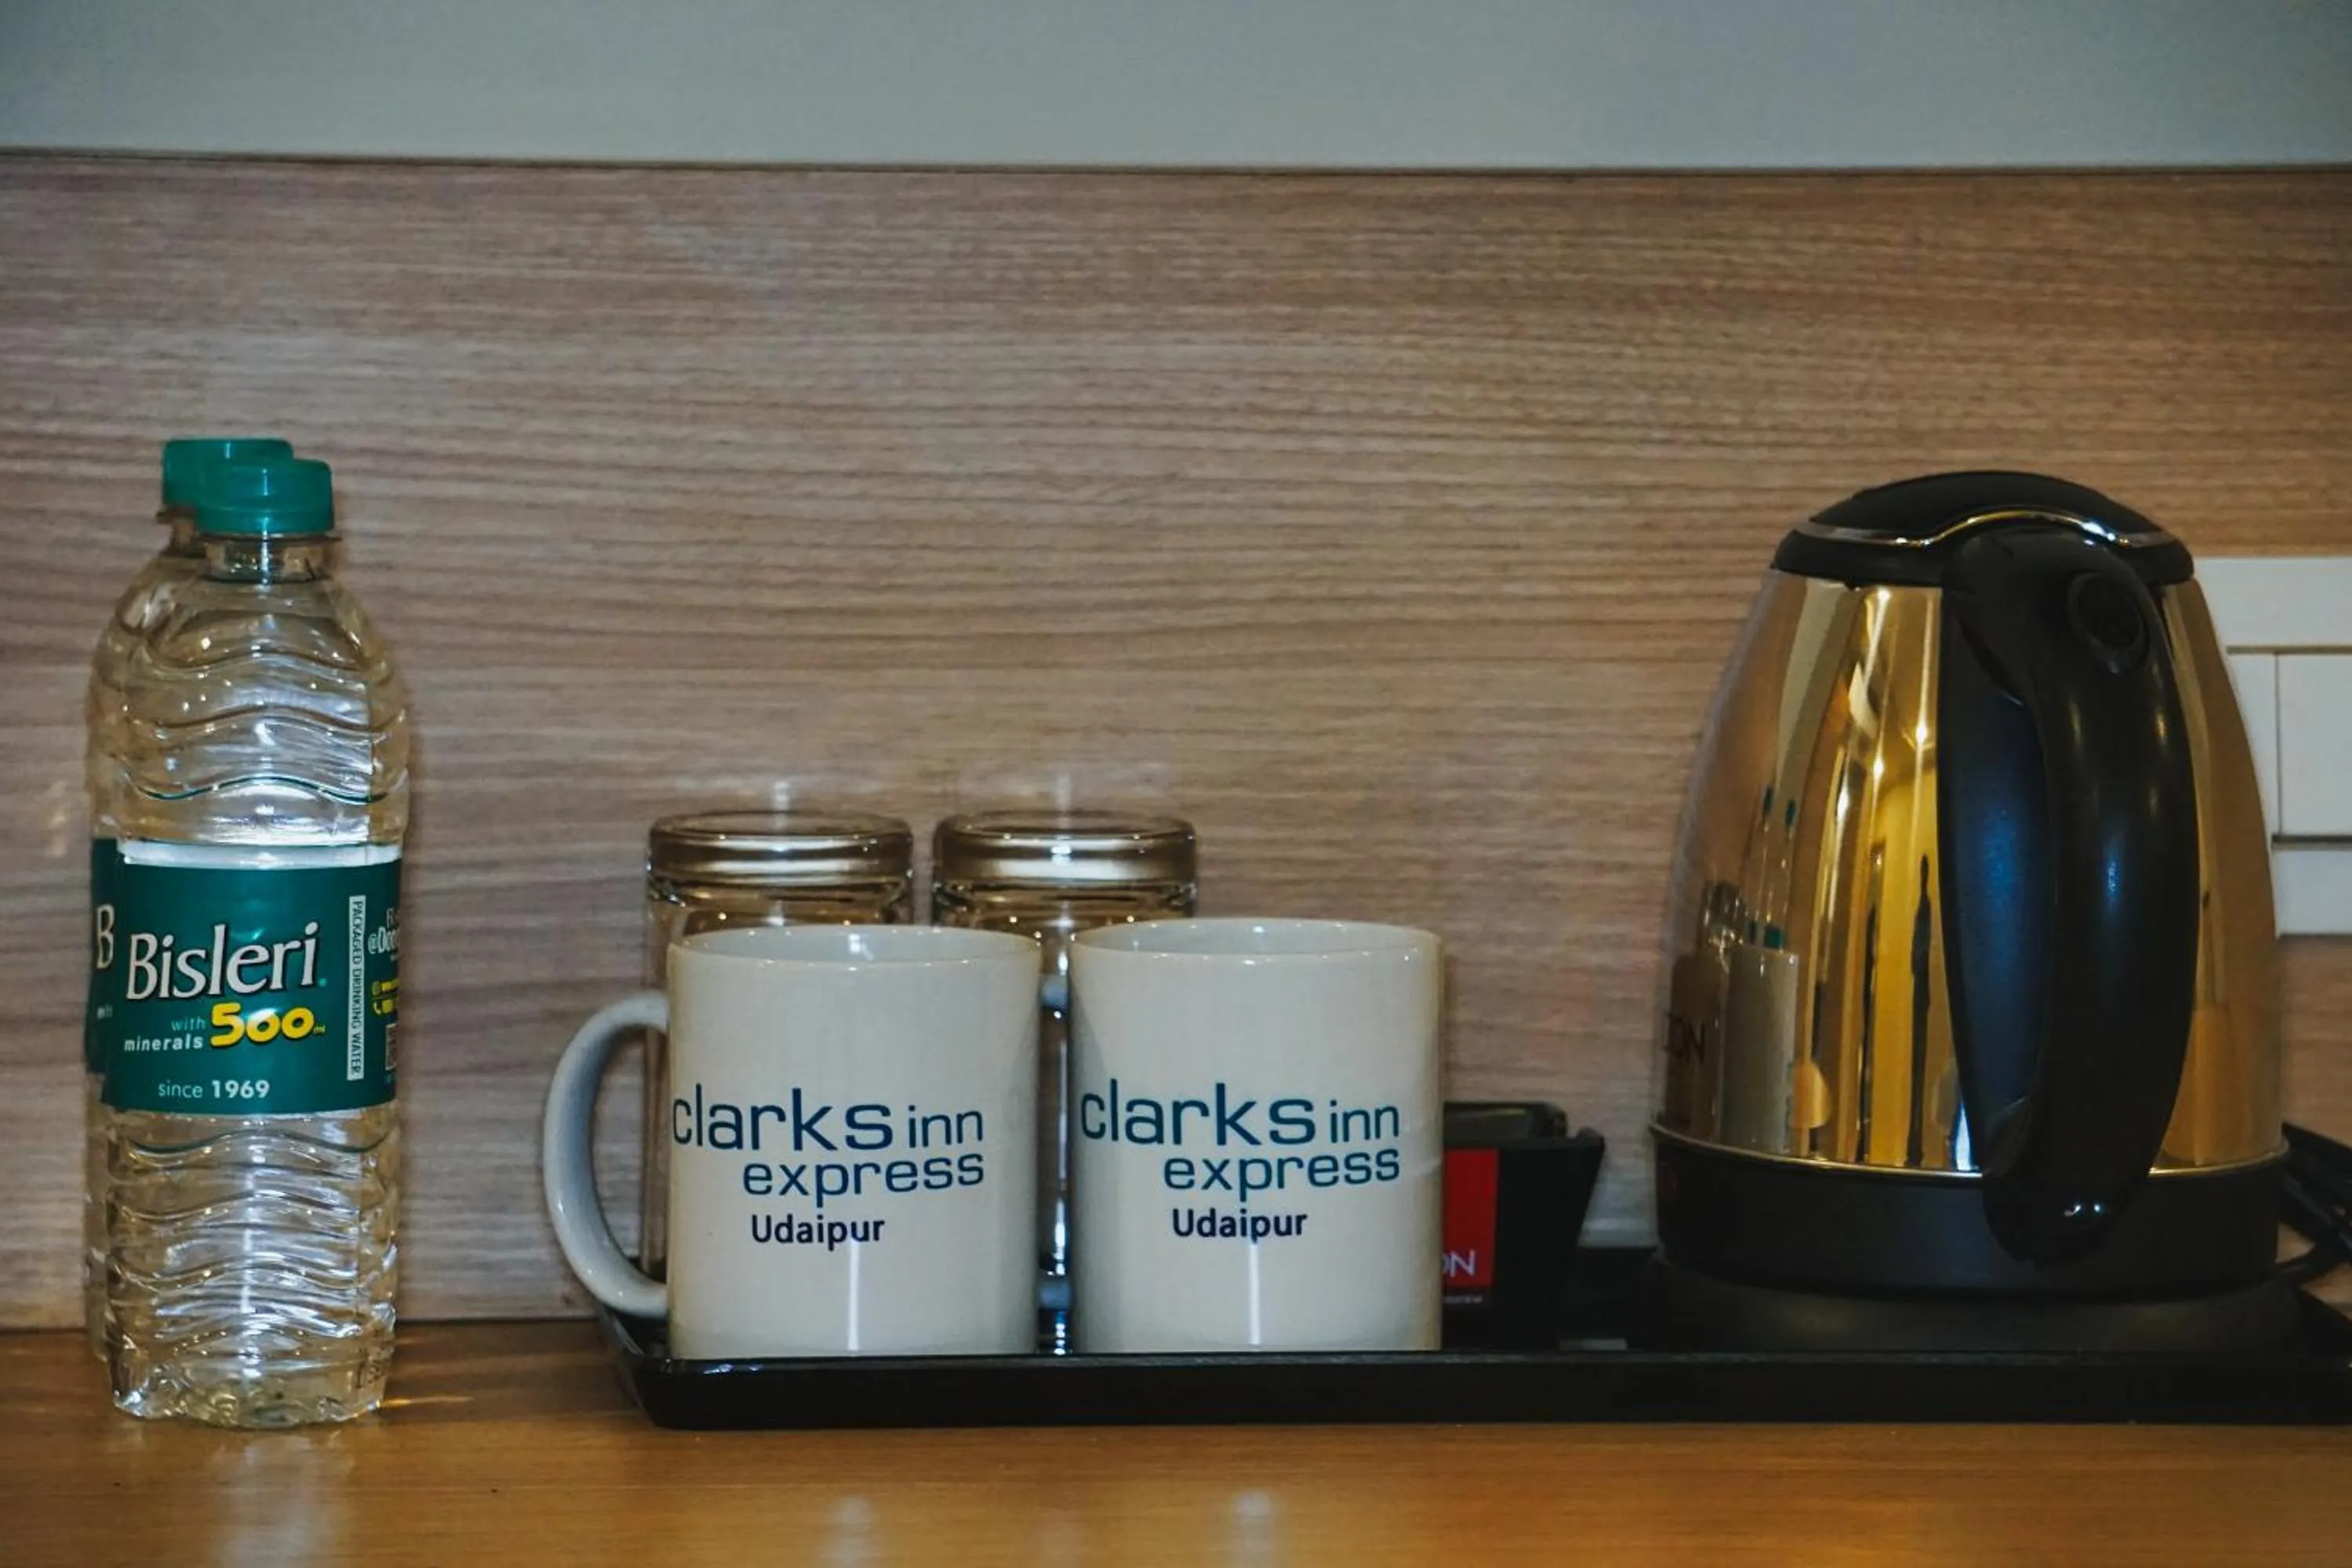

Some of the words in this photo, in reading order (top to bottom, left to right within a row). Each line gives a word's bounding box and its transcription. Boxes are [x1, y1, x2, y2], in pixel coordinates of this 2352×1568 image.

[126, 921, 318, 1000] Bisleri
[351, 901, 364, 965] PACKAGED
[171, 1016, 206, 1032] with
[351, 968, 363, 1029] DRINKING
[124, 1033, 204, 1052] minerals
[350, 1032, 362, 1076] WATER
[158, 1079, 203, 1098] since
[212, 1080, 270, 1099] 1969
[1080, 1078, 1316, 1146] clarks
[1330, 1099, 1400, 1144] inn
[673, 1083, 894, 1152] clarks
[909, 1105, 984, 1149] inn
[743, 1153, 985, 1208] express
[1163, 1148, 1400, 1203] express
[751, 1213, 886, 1252] Udaipur
[1172, 1208, 1308, 1244] Udaipur
